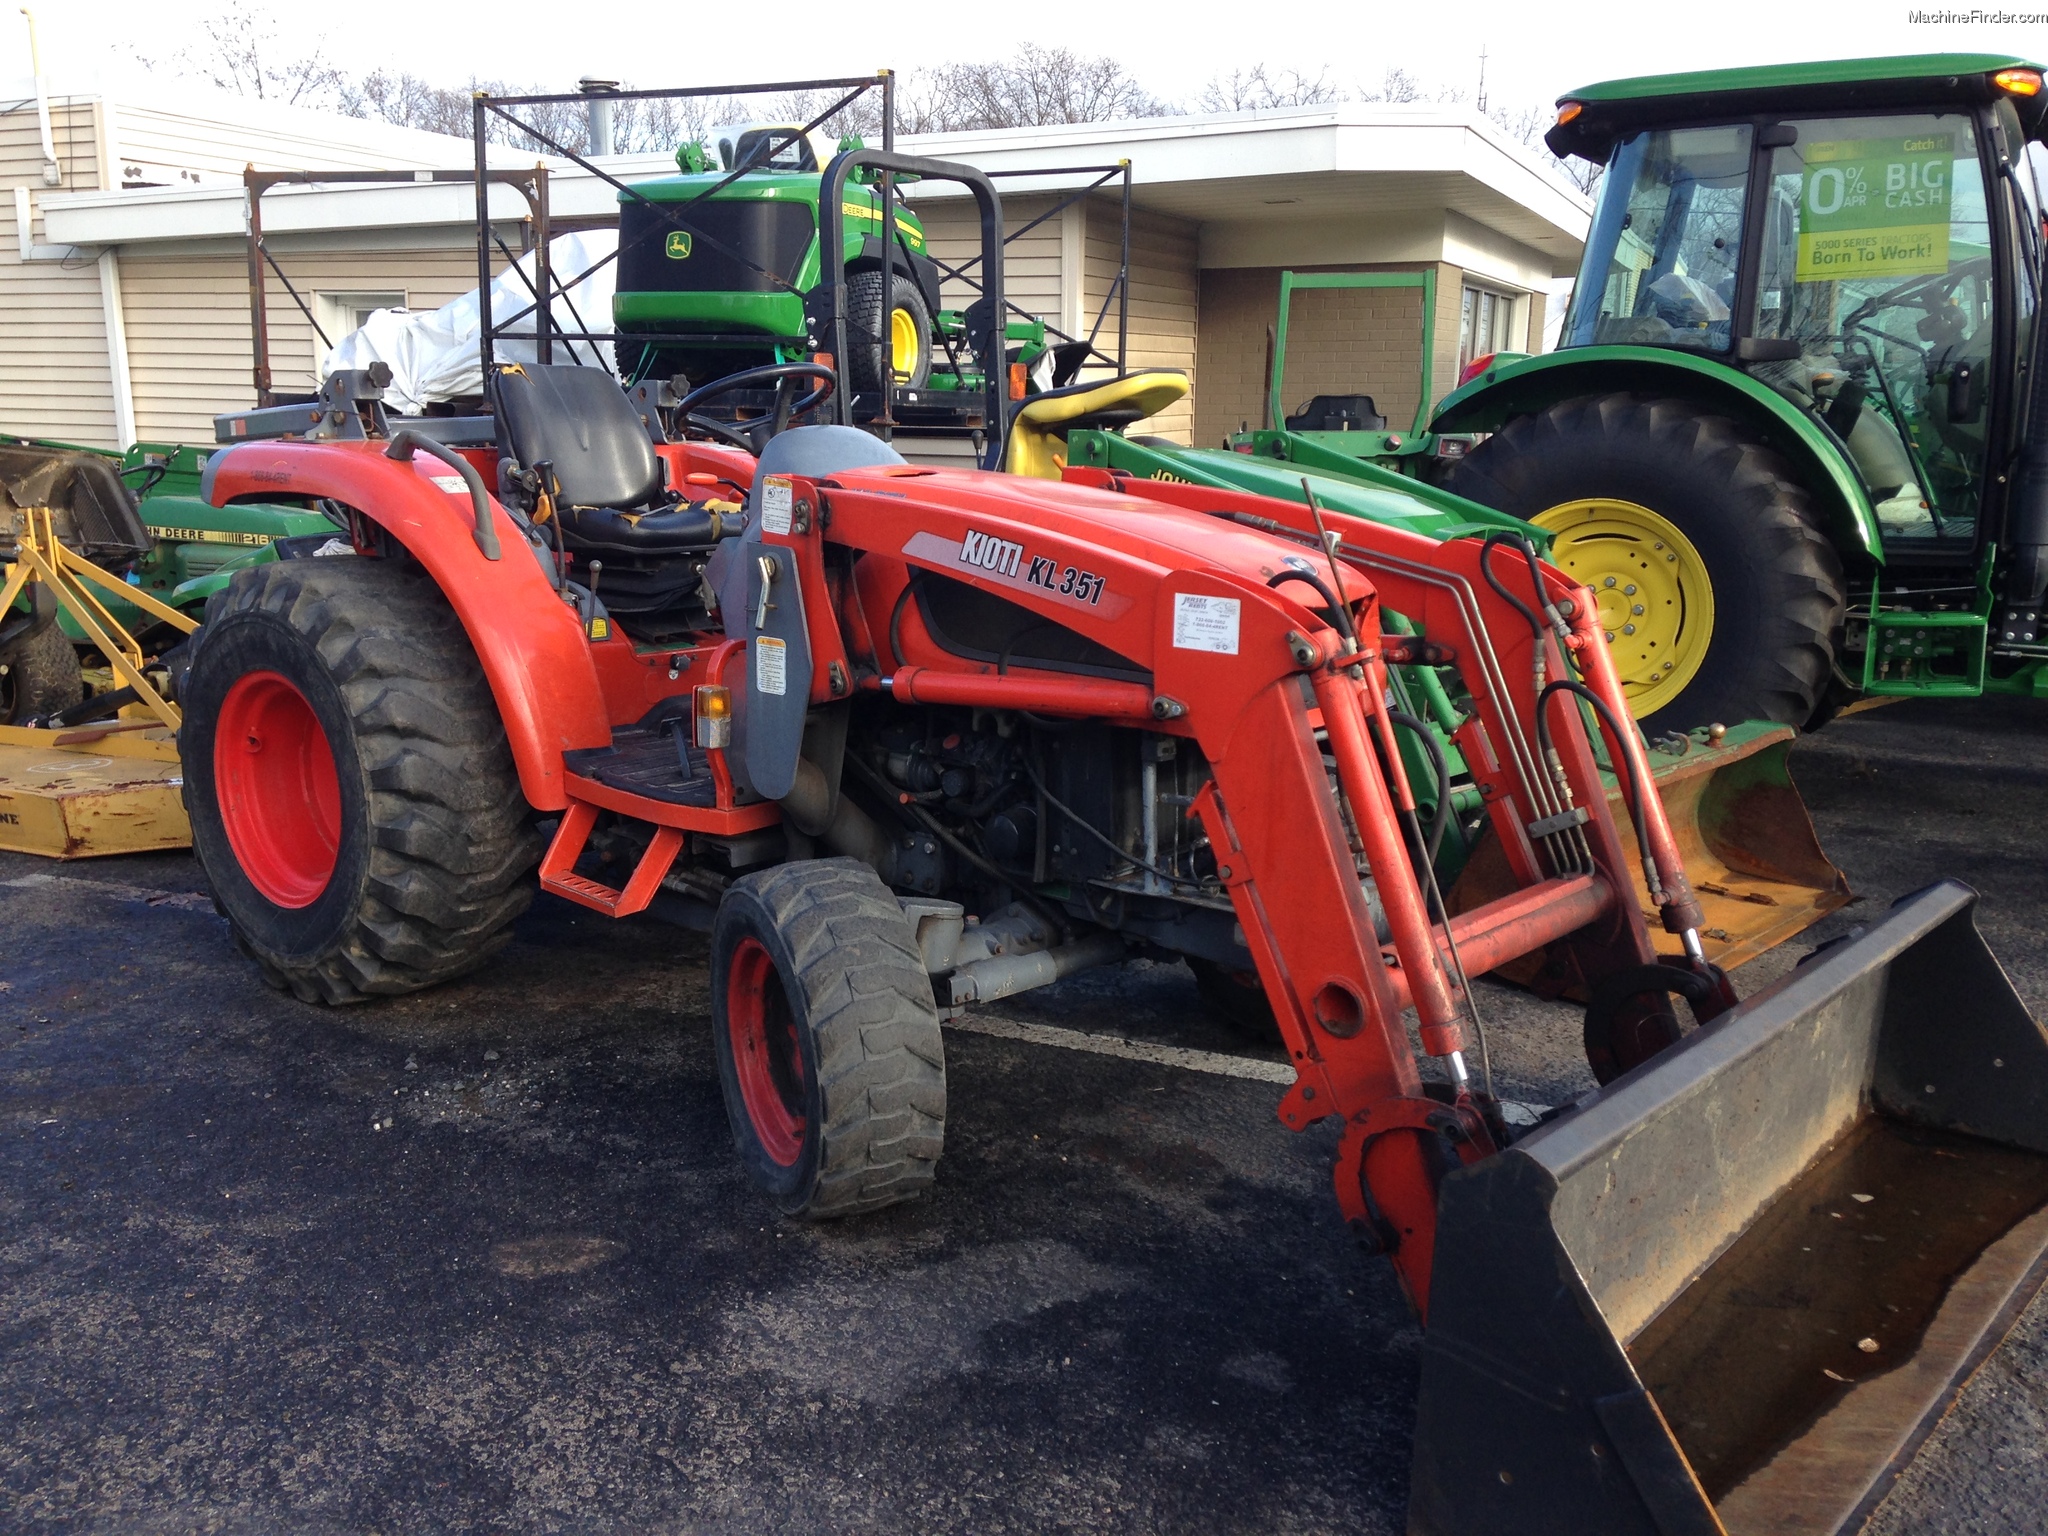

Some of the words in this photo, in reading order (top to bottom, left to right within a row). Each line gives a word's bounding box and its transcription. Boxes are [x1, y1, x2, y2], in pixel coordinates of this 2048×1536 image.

[1904, 139, 1935, 151] Catch
[1886, 160, 1945, 191] BIG
[1843, 195, 1867, 208] APR
[1885, 189, 1943, 208] CASH
[1815, 239, 1841, 250] 5000
[1843, 236, 1878, 248] SERIES
[1881, 233, 1932, 245] TRACTORS
[1812, 250, 1852, 265] Born
[1857, 247, 1876, 262] To
[1881, 243, 1933, 260] Work!
[165, 528, 204, 540] DEERE
[243, 533, 269, 544] 216
[959, 529, 1024, 578] KIOTI
